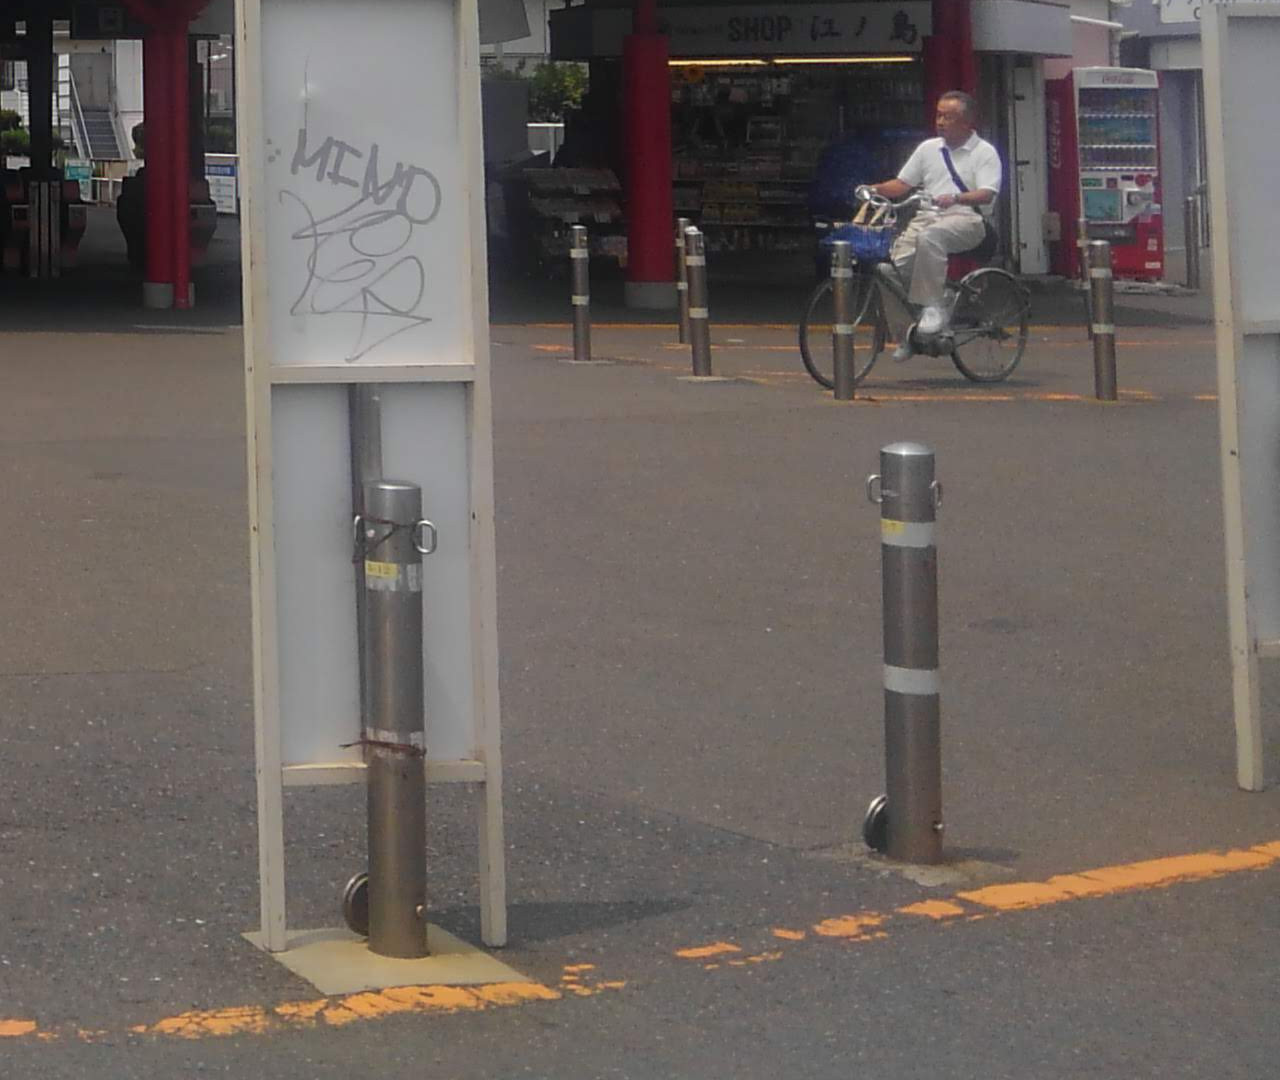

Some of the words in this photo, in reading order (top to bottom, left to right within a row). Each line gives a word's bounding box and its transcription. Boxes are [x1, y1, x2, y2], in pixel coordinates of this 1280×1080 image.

[728, 16, 791, 42] SHOP
[810, 10, 918, 45] 江ノ島
